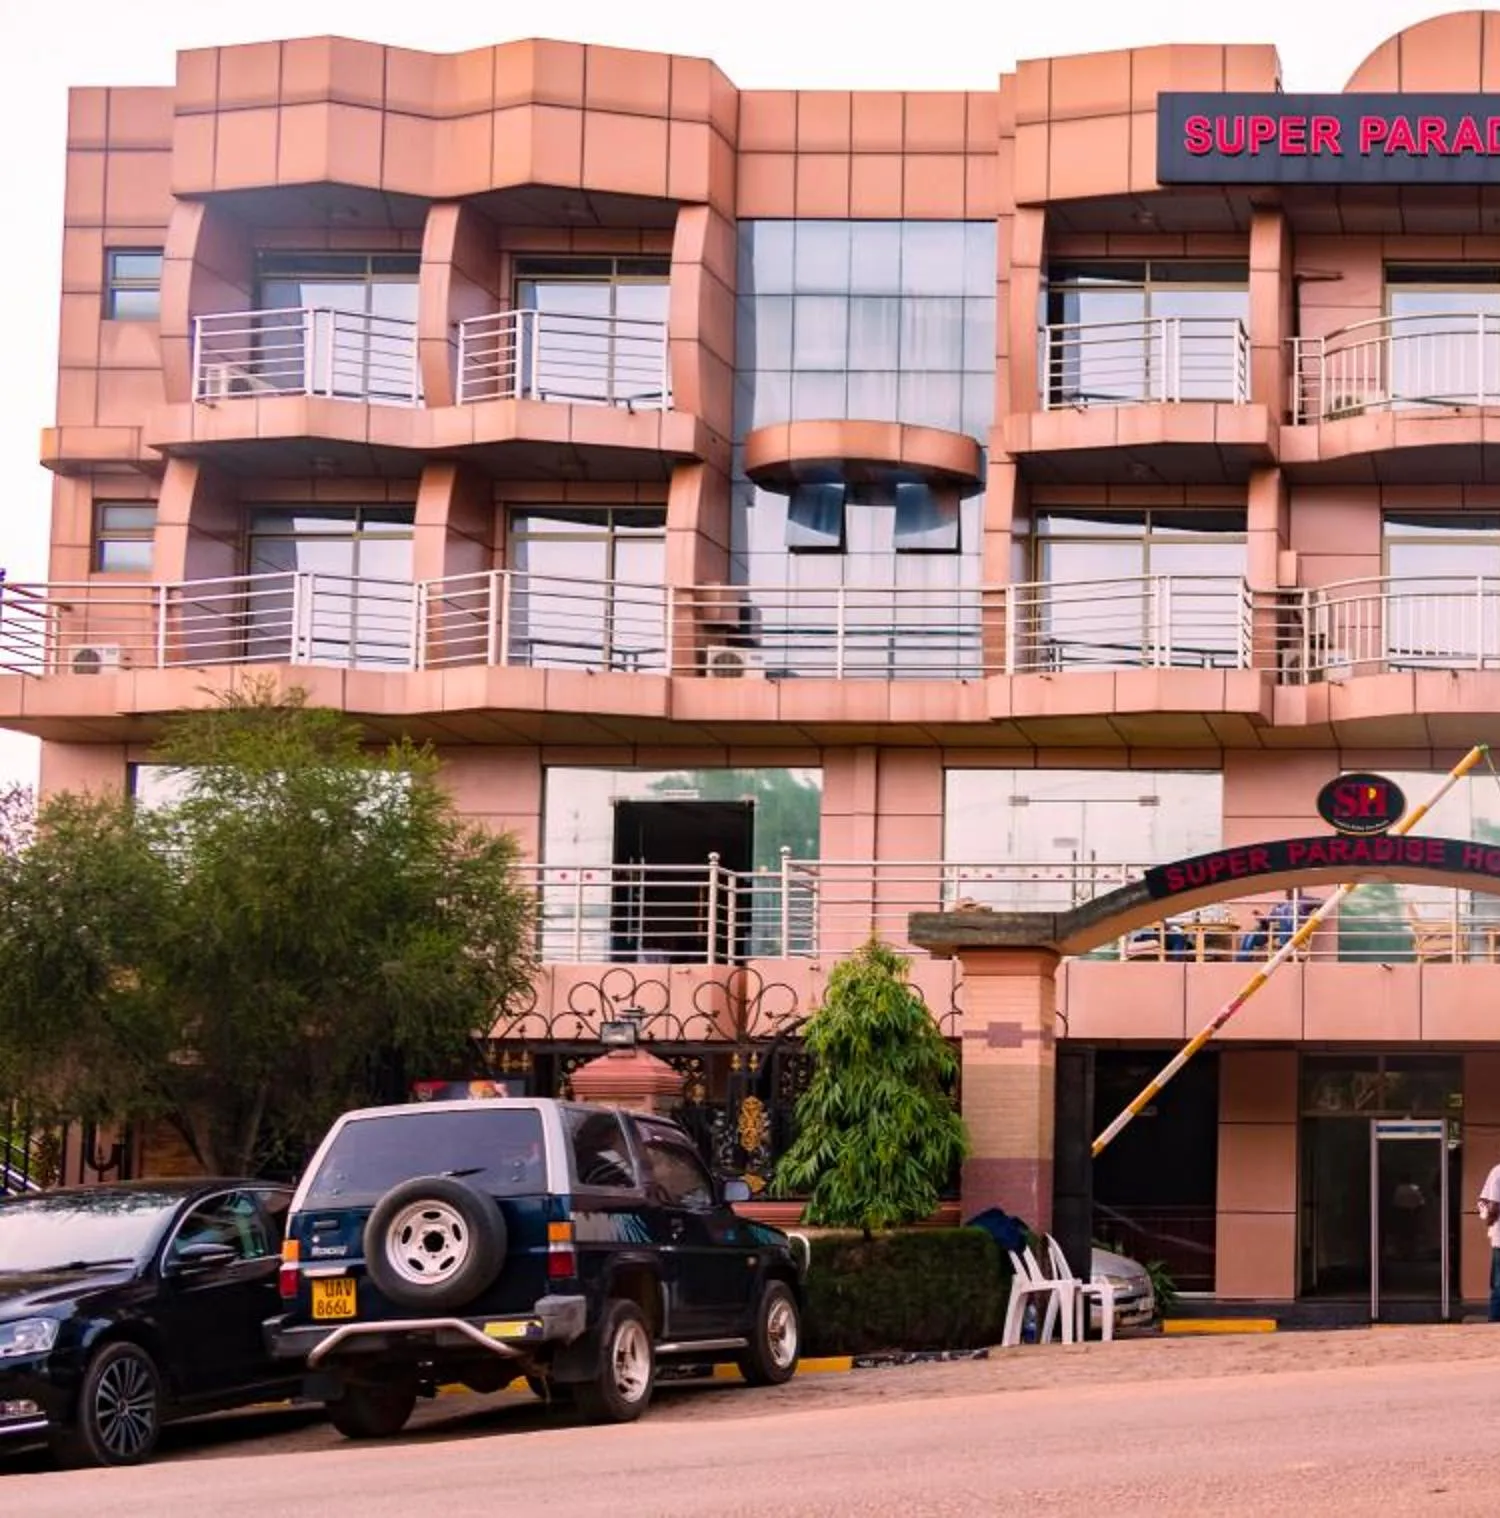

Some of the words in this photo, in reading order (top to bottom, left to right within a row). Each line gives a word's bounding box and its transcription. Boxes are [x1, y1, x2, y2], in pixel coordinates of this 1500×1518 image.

[1184, 115, 1342, 156] SUPER
[1165, 847, 1272, 892] SUPER
[1287, 838, 1446, 866] PARADISE
[325, 1280, 352, 1296] UAV
[316, 1299, 352, 1315] 866L
